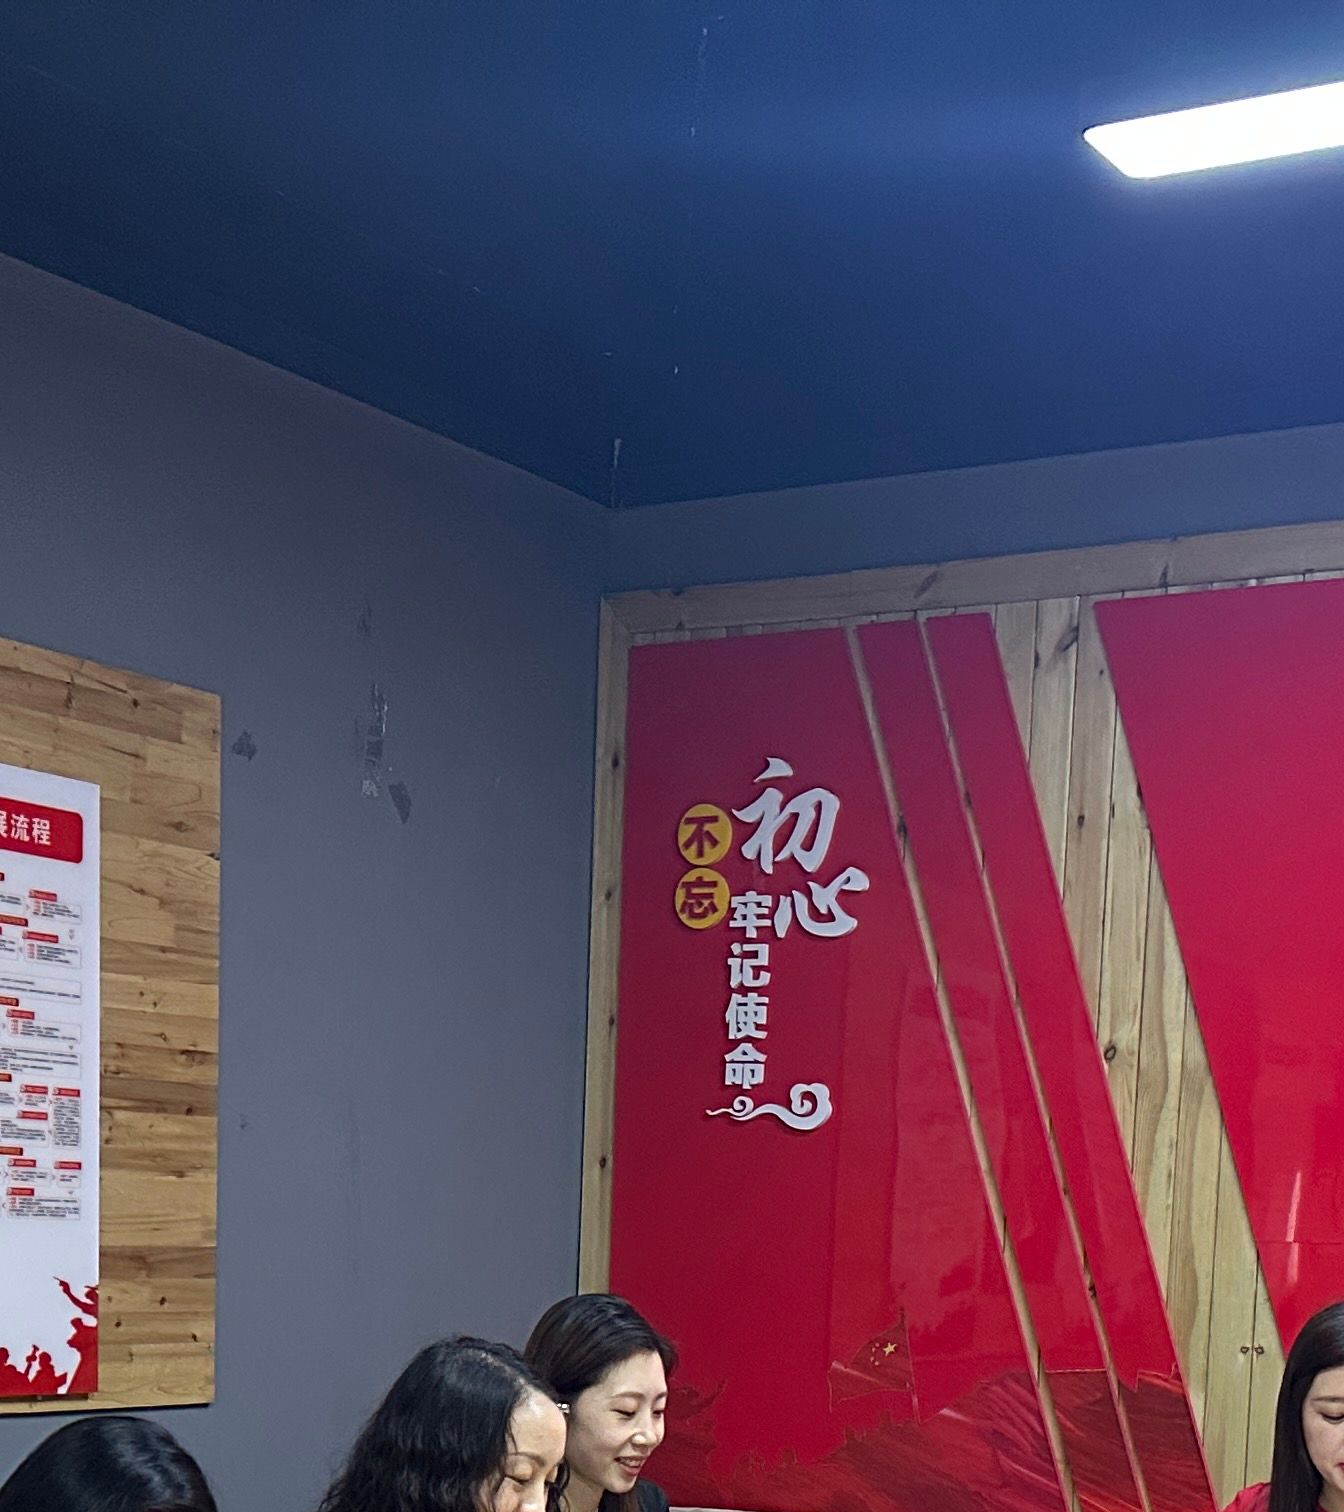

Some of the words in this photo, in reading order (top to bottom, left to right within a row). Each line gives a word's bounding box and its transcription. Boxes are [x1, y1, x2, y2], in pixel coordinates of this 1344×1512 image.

[679, 814, 721, 921] 不忘
[732, 757, 870, 938] 初心
[724, 891, 773, 1090] 牢记使命
